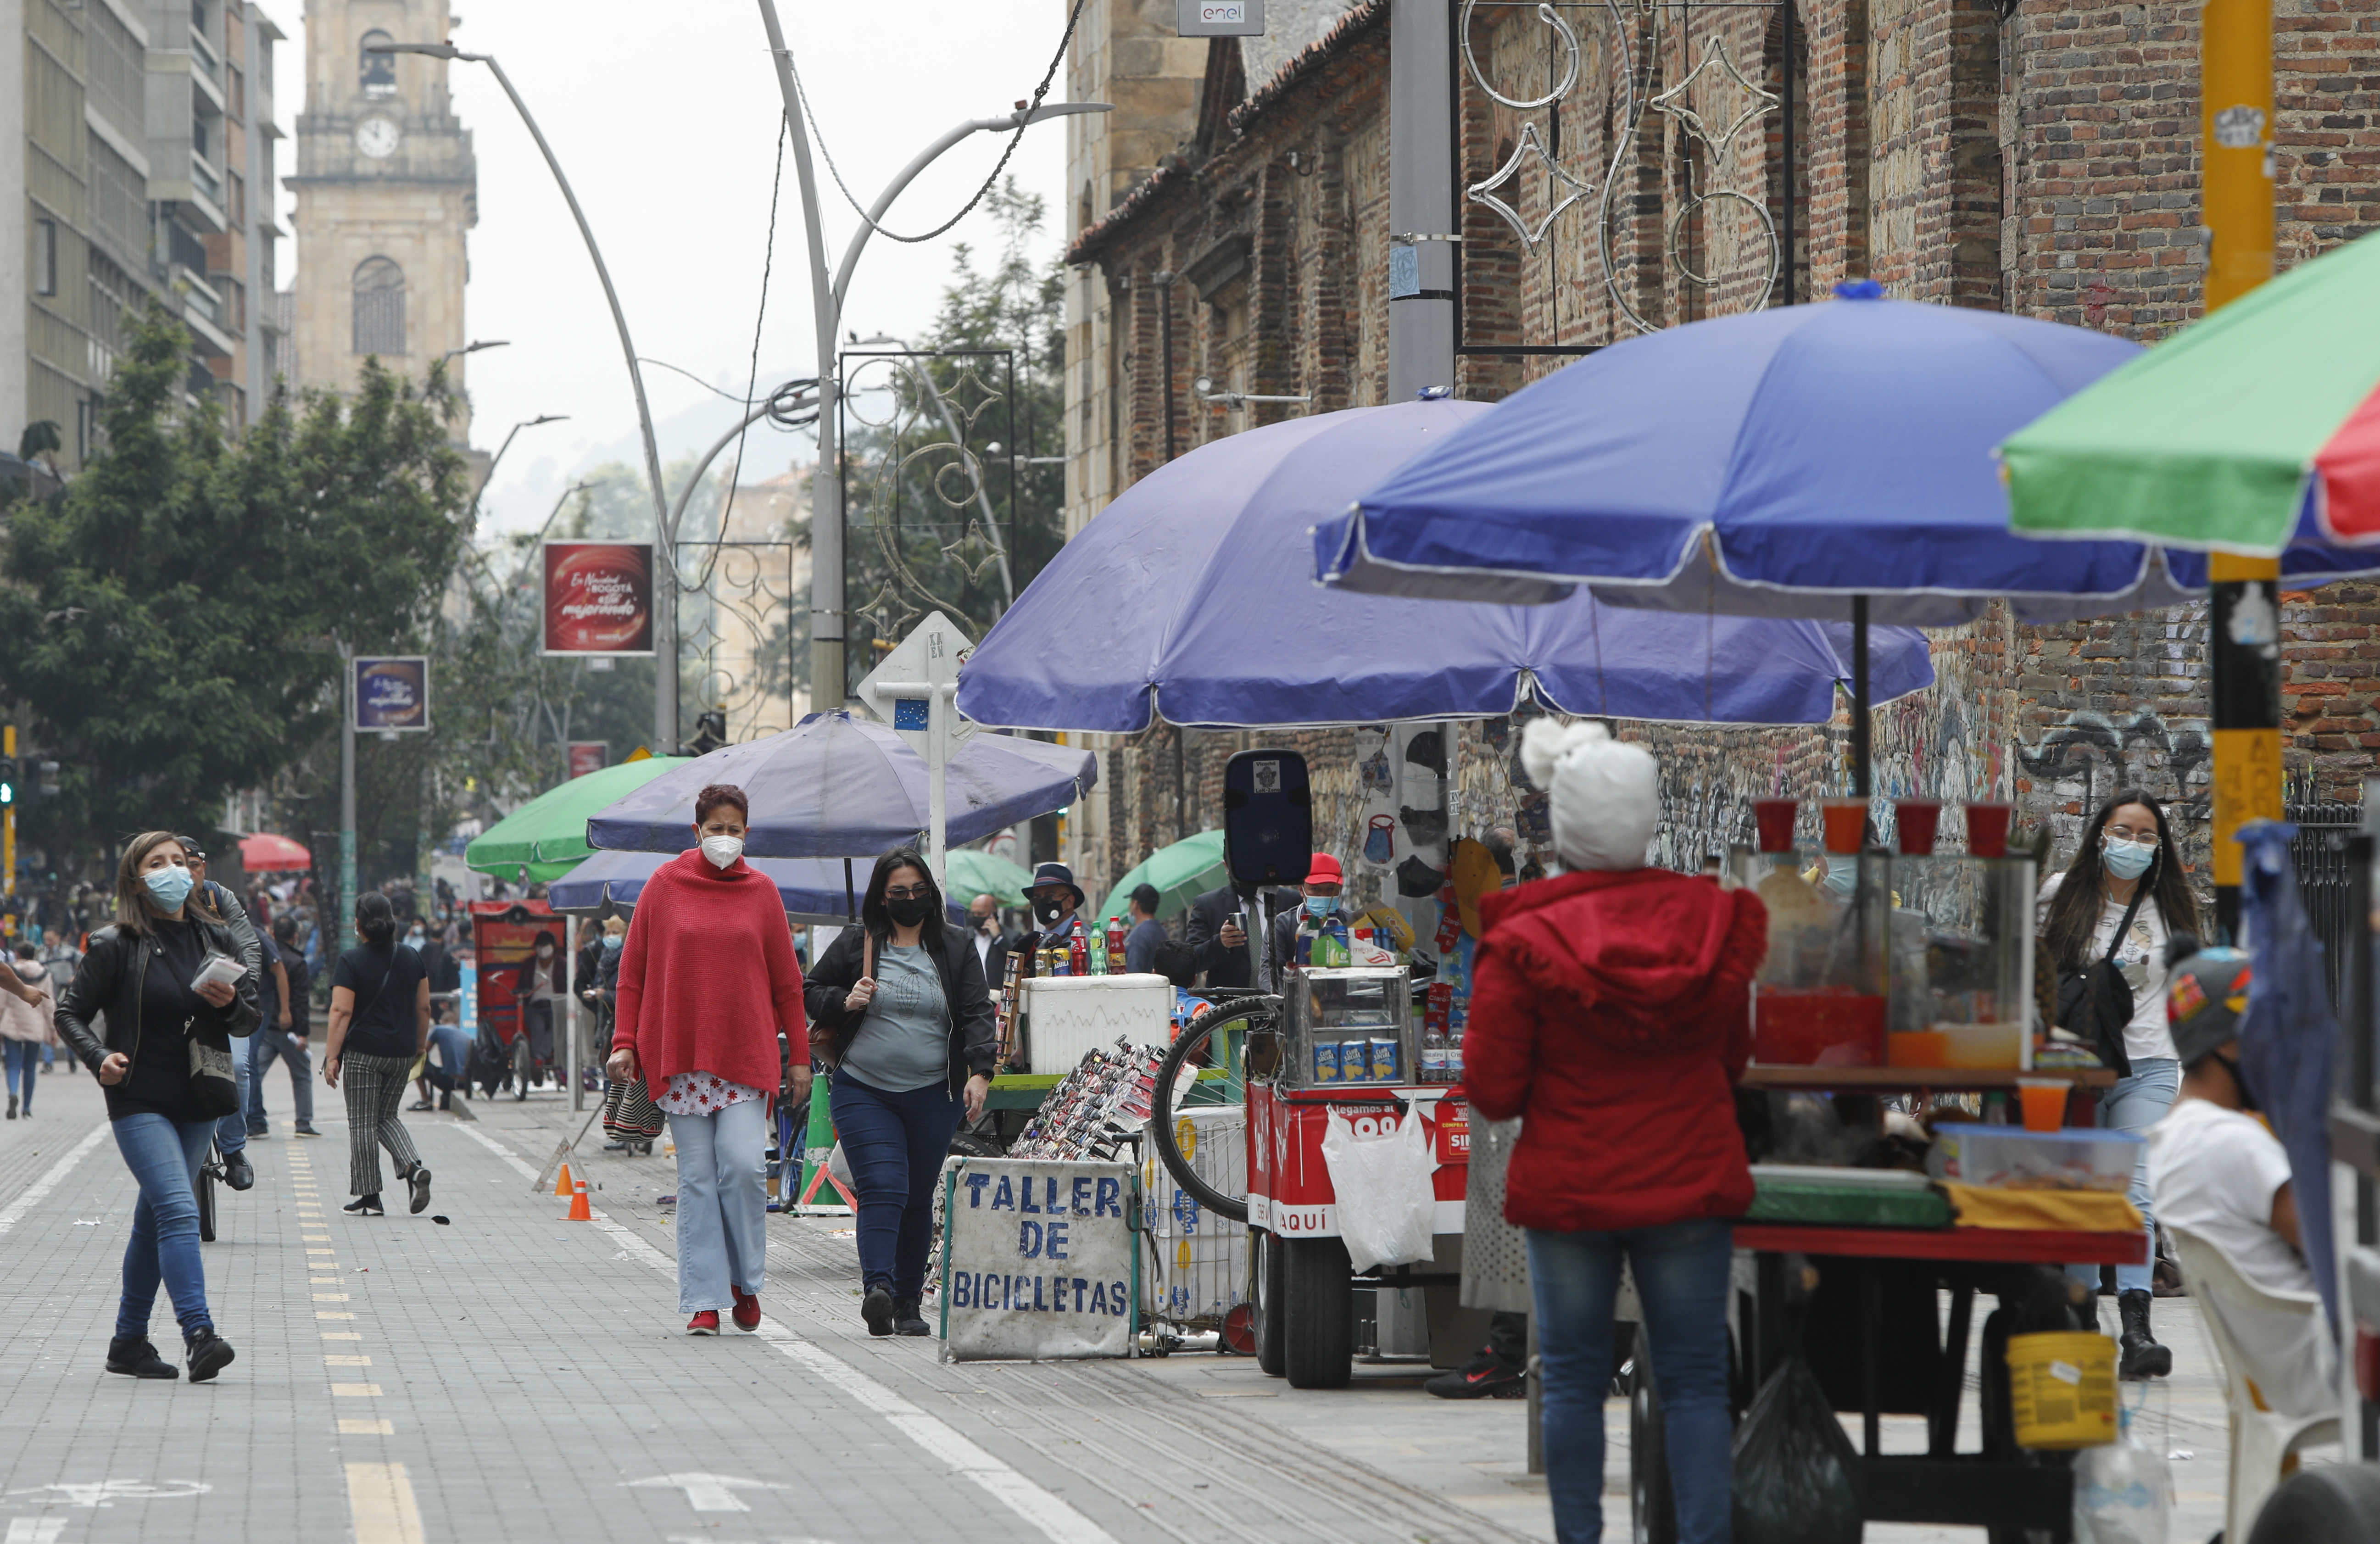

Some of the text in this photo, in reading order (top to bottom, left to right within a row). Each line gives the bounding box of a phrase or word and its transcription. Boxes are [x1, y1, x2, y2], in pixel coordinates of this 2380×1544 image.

[1203, 5, 1241, 19] enel
[571, 572, 583, 587] En
[562, 598, 635, 619] mejorando
[965, 1173, 1121, 1217] TALLER
[1020, 1221, 1069, 1259] DE
[953, 1271, 1126, 1316] BICICLETAS
